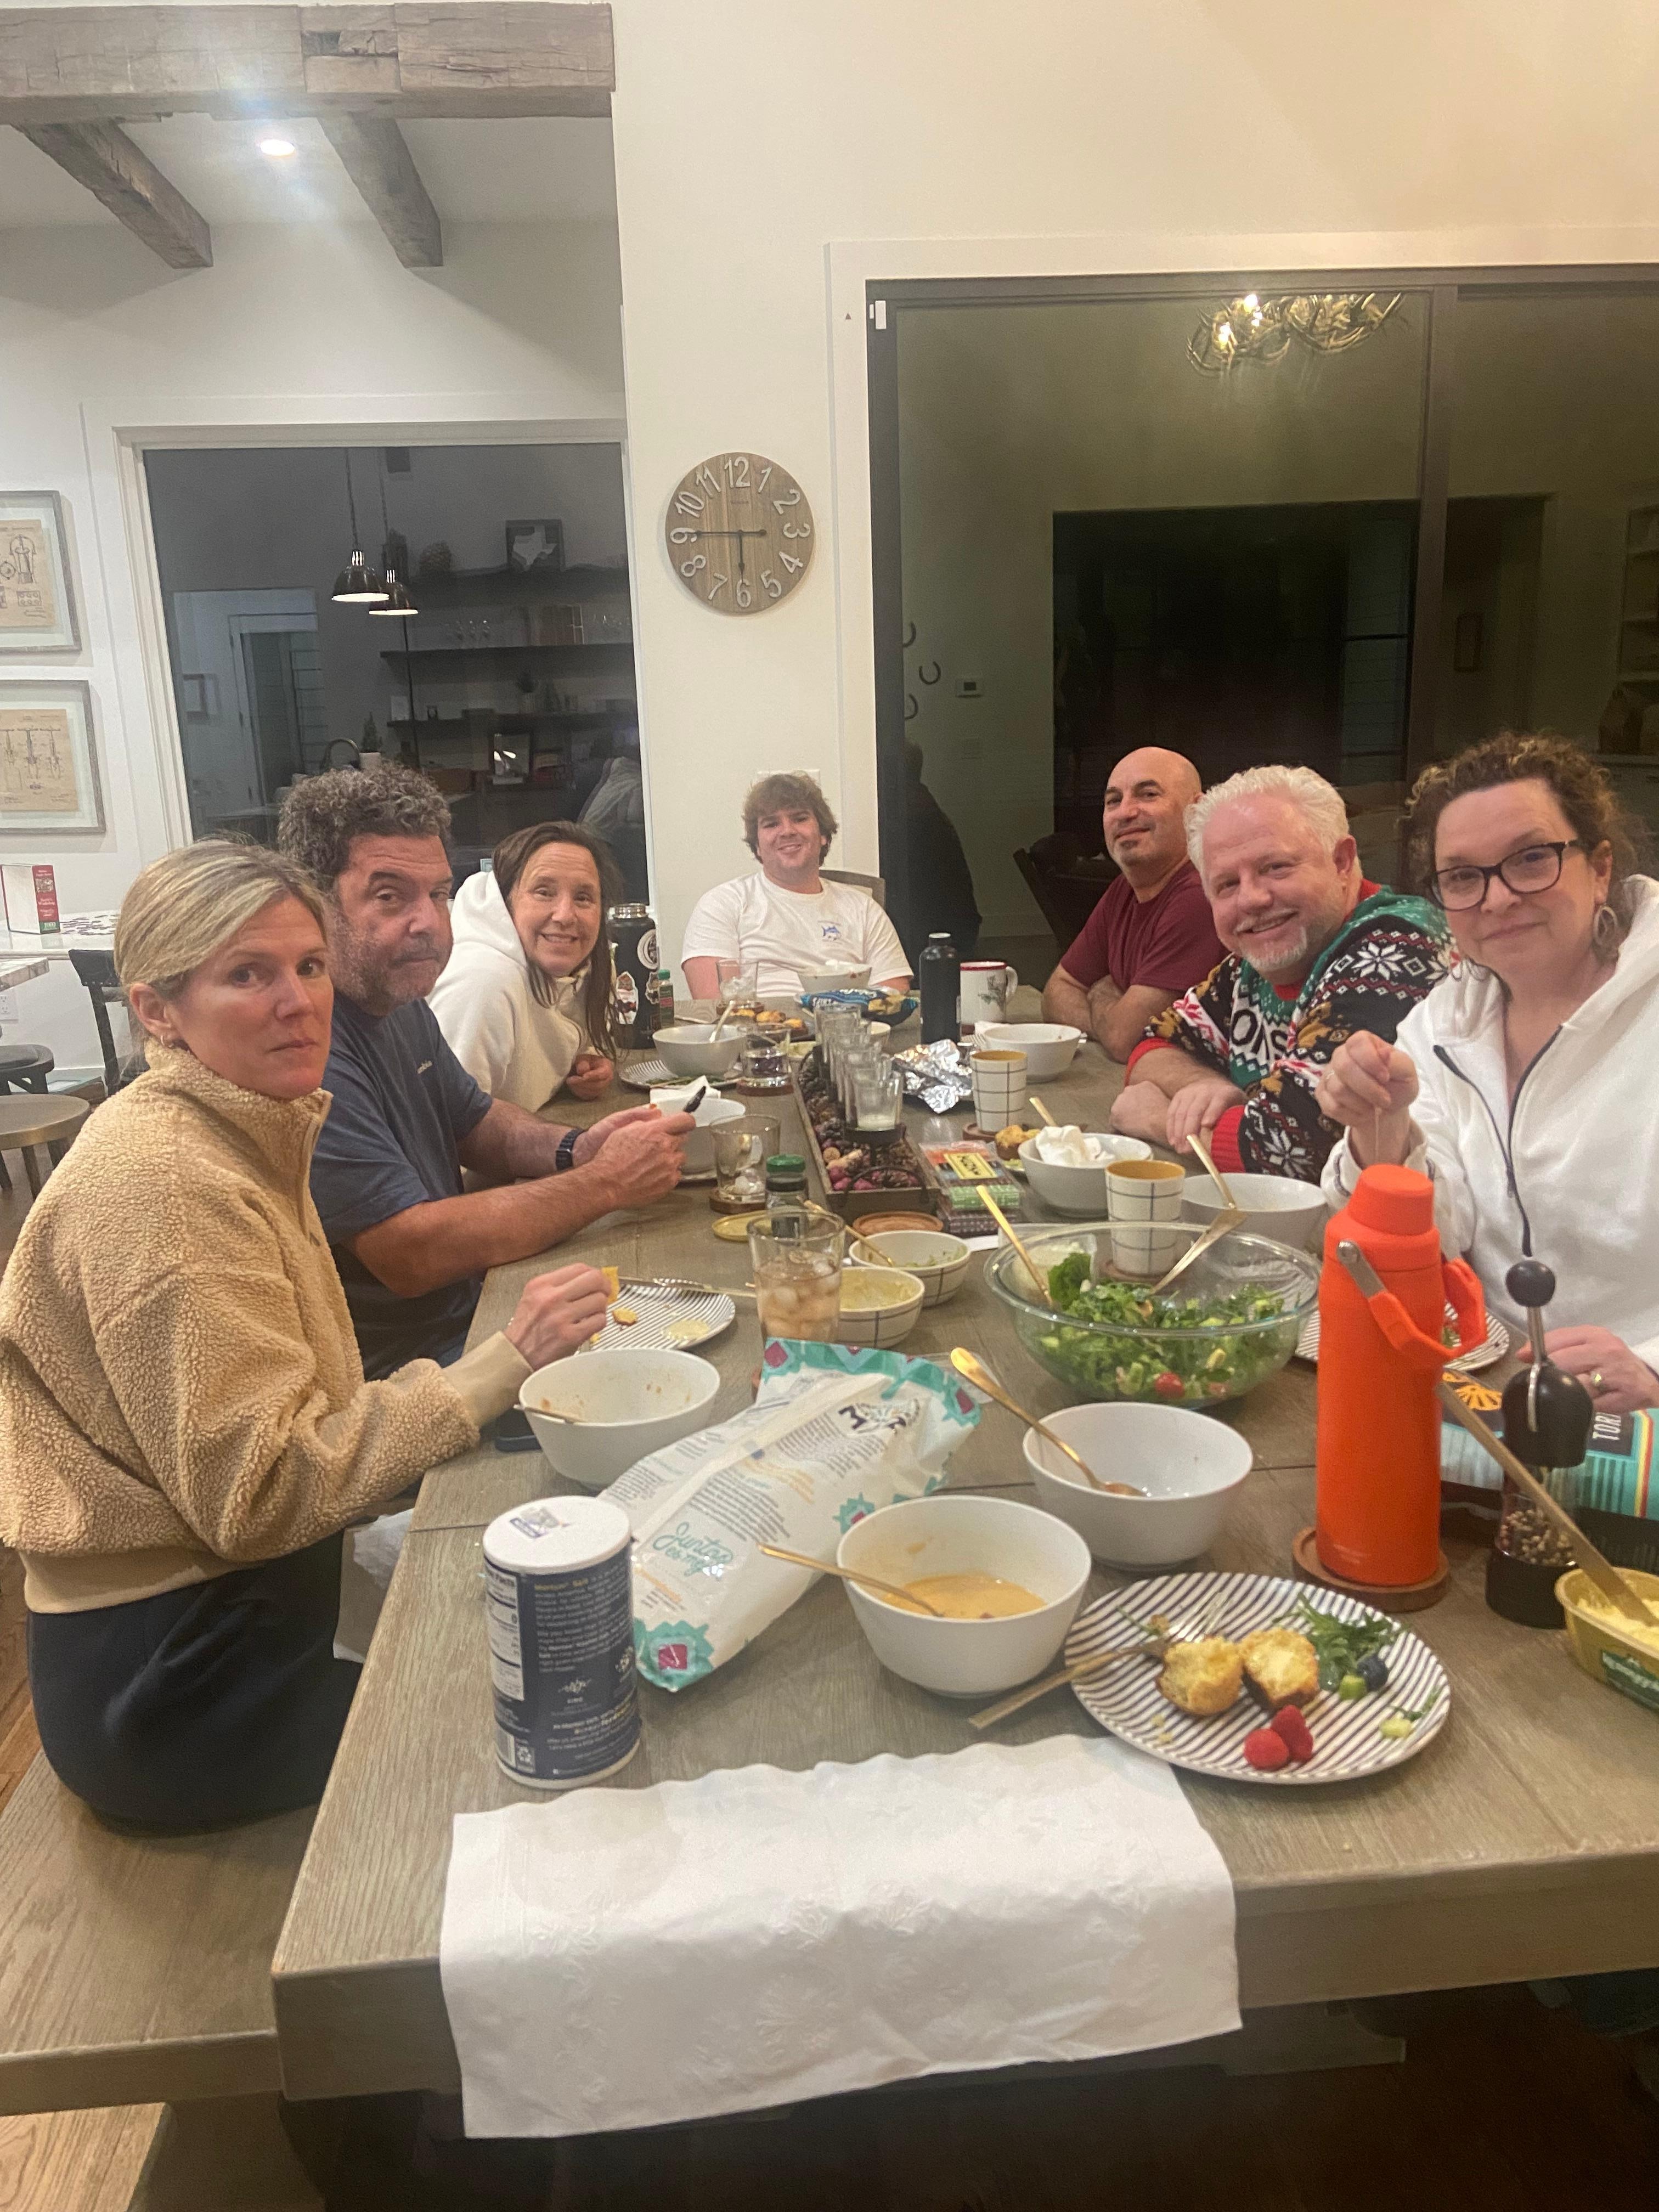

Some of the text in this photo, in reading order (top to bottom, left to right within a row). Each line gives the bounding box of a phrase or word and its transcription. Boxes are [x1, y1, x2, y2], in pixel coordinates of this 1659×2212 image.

[695, 466, 721, 498] 11
[724, 456, 751, 488] 12
[758, 466, 773, 493] 1
[674, 490, 704, 518] 10
[772, 488, 801, 515] 2
[670, 527, 698, 544] 9
[782, 522, 811, 538] 3
[681, 554, 706, 577] 8
[778, 551, 804, 574] 4
[708, 572, 728, 600] 7
[736, 578, 752, 608] 6
[760, 569, 782, 597] 5
